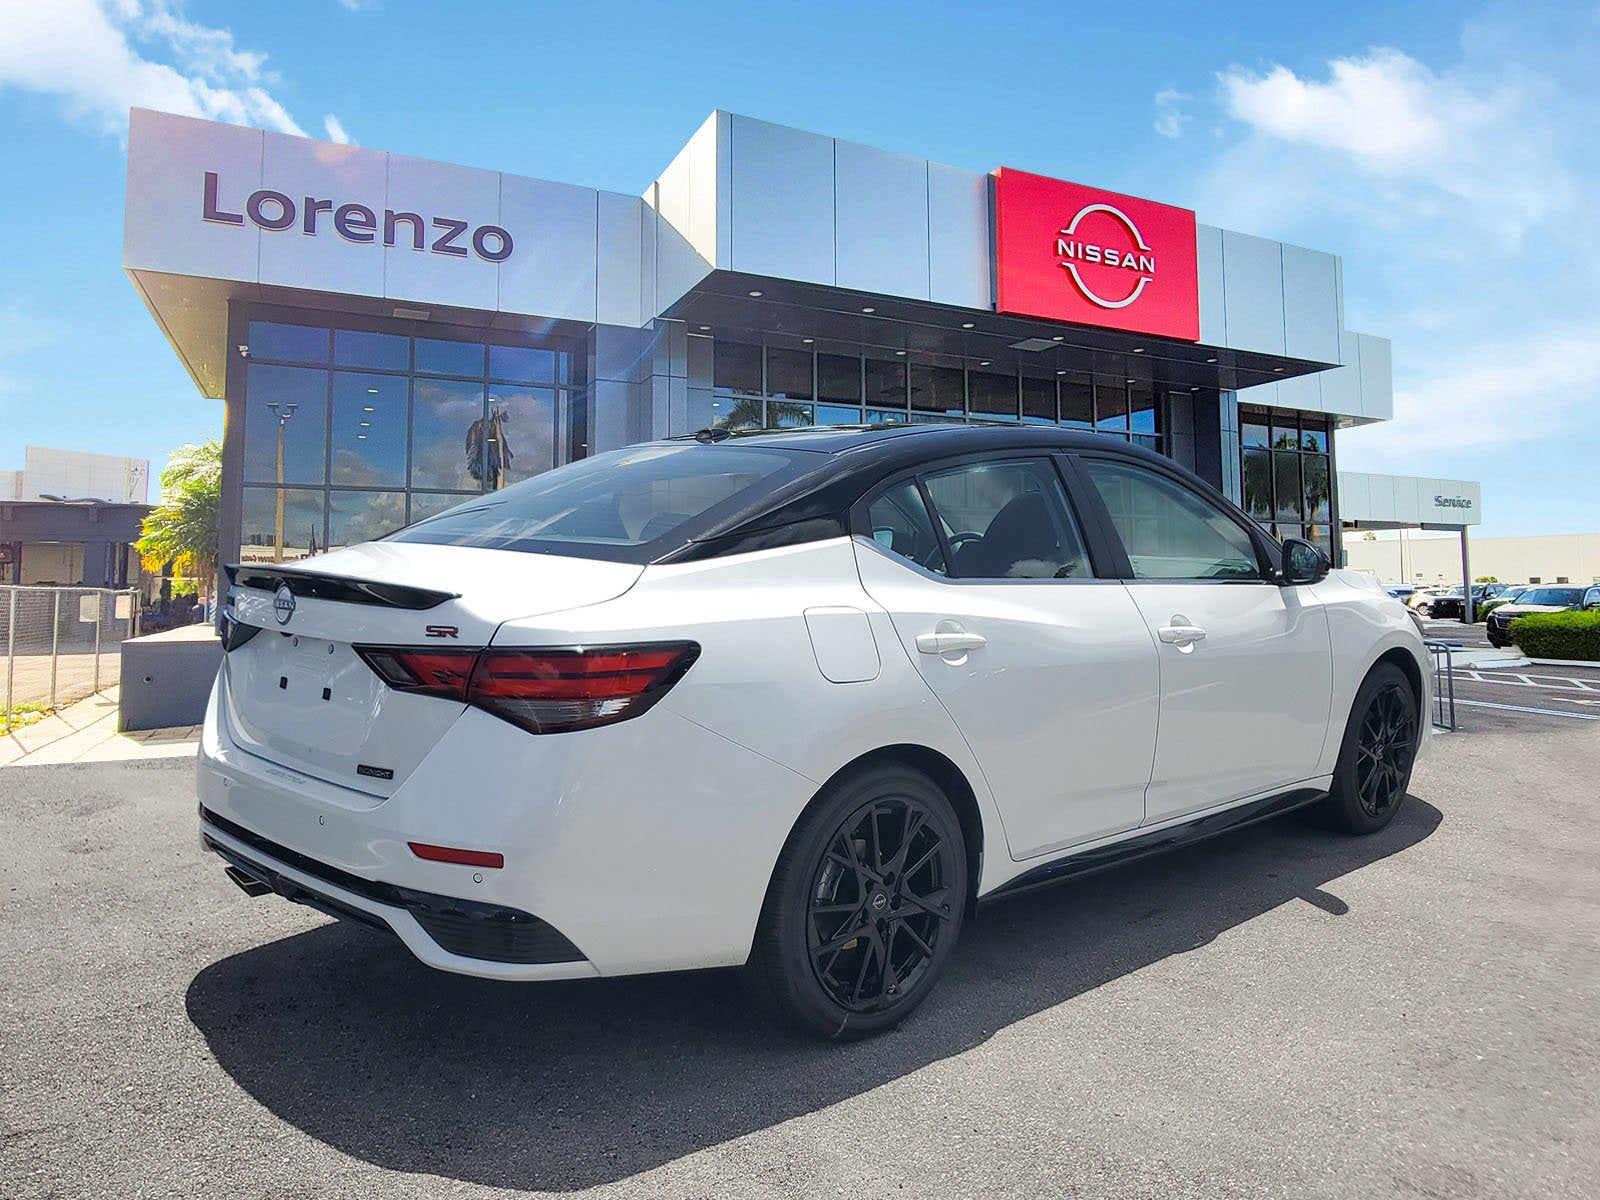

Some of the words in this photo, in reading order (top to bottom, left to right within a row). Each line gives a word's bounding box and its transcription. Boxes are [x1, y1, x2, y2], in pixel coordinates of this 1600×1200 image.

[202, 170, 514, 263] Lorenzo
[1057, 238, 1155, 273] NISSAN
[1434, 495, 1472, 509] Service
[425, 624, 459, 639] SR
